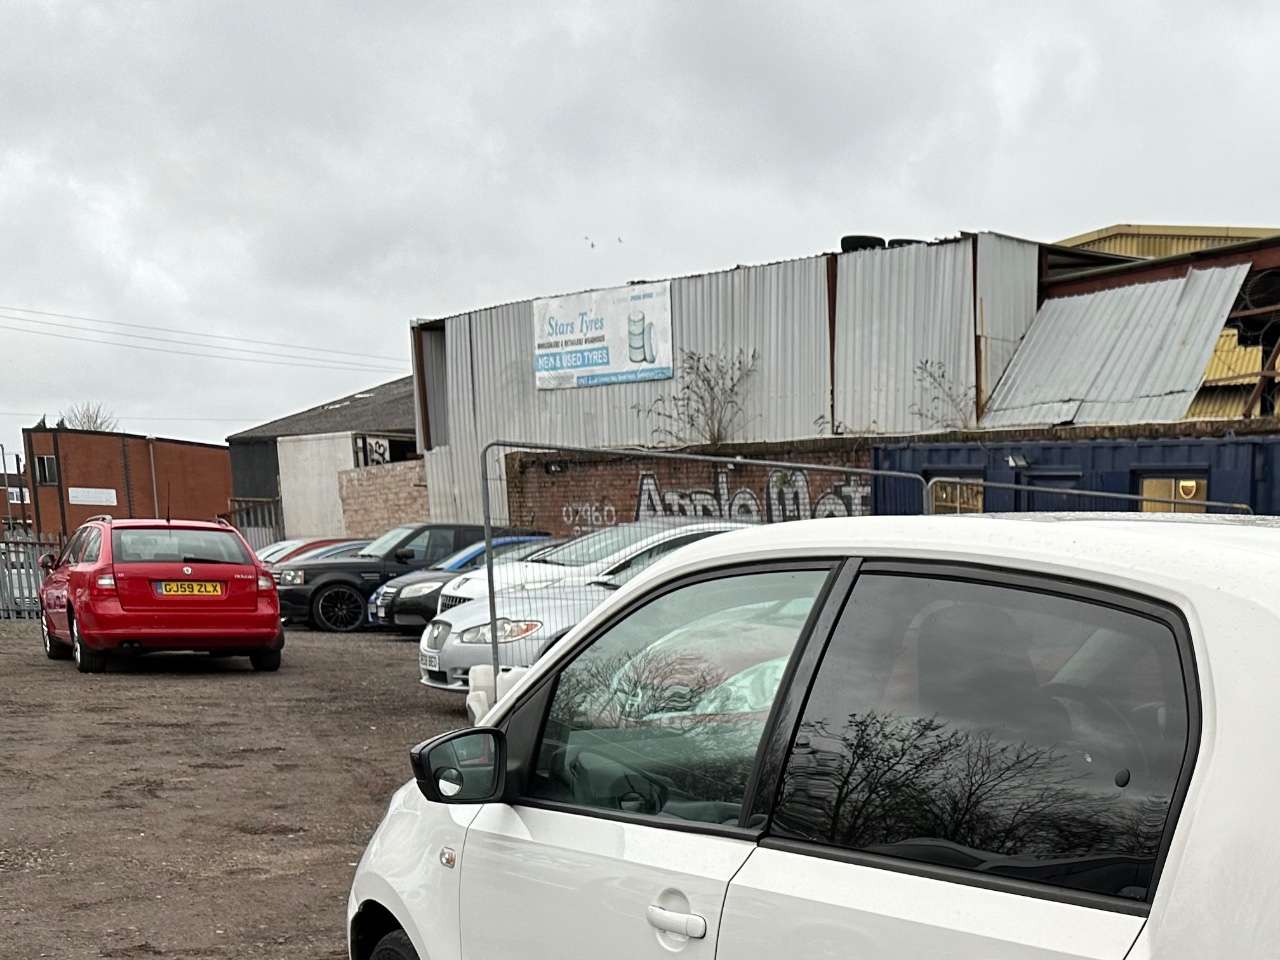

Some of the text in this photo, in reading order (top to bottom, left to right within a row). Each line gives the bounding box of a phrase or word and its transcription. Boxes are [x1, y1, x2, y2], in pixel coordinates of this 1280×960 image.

[547, 311, 605, 338] Stars Tyres
[562, 352, 583, 367] USED
[583, 349, 608, 365] TYRES
[164, 583, 219, 593] GJ59 ZLX
